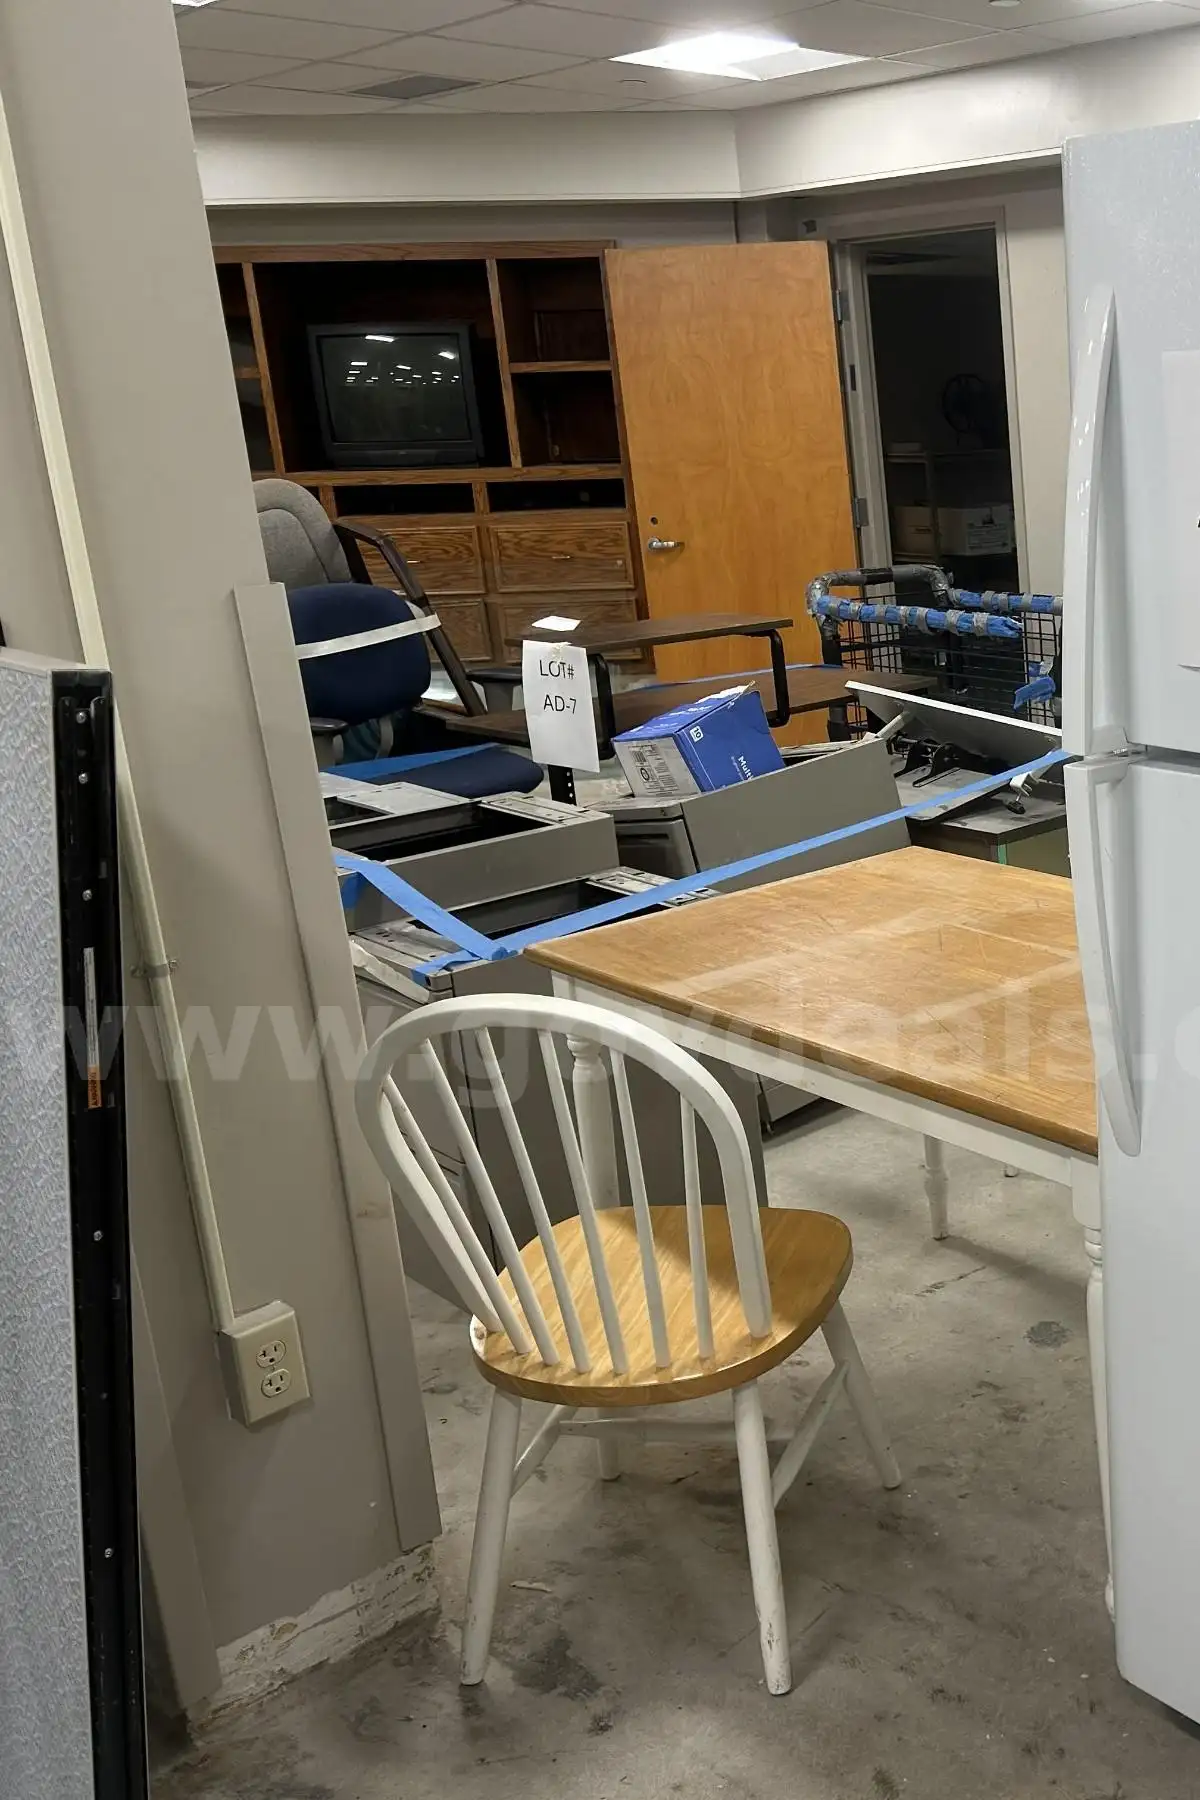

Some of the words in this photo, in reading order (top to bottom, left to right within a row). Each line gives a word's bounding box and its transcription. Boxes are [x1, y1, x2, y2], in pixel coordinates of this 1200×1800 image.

[539, 659, 575, 680] LOT#
[543, 695, 577, 714] AD-7
[693, 727, 702, 739] 10
